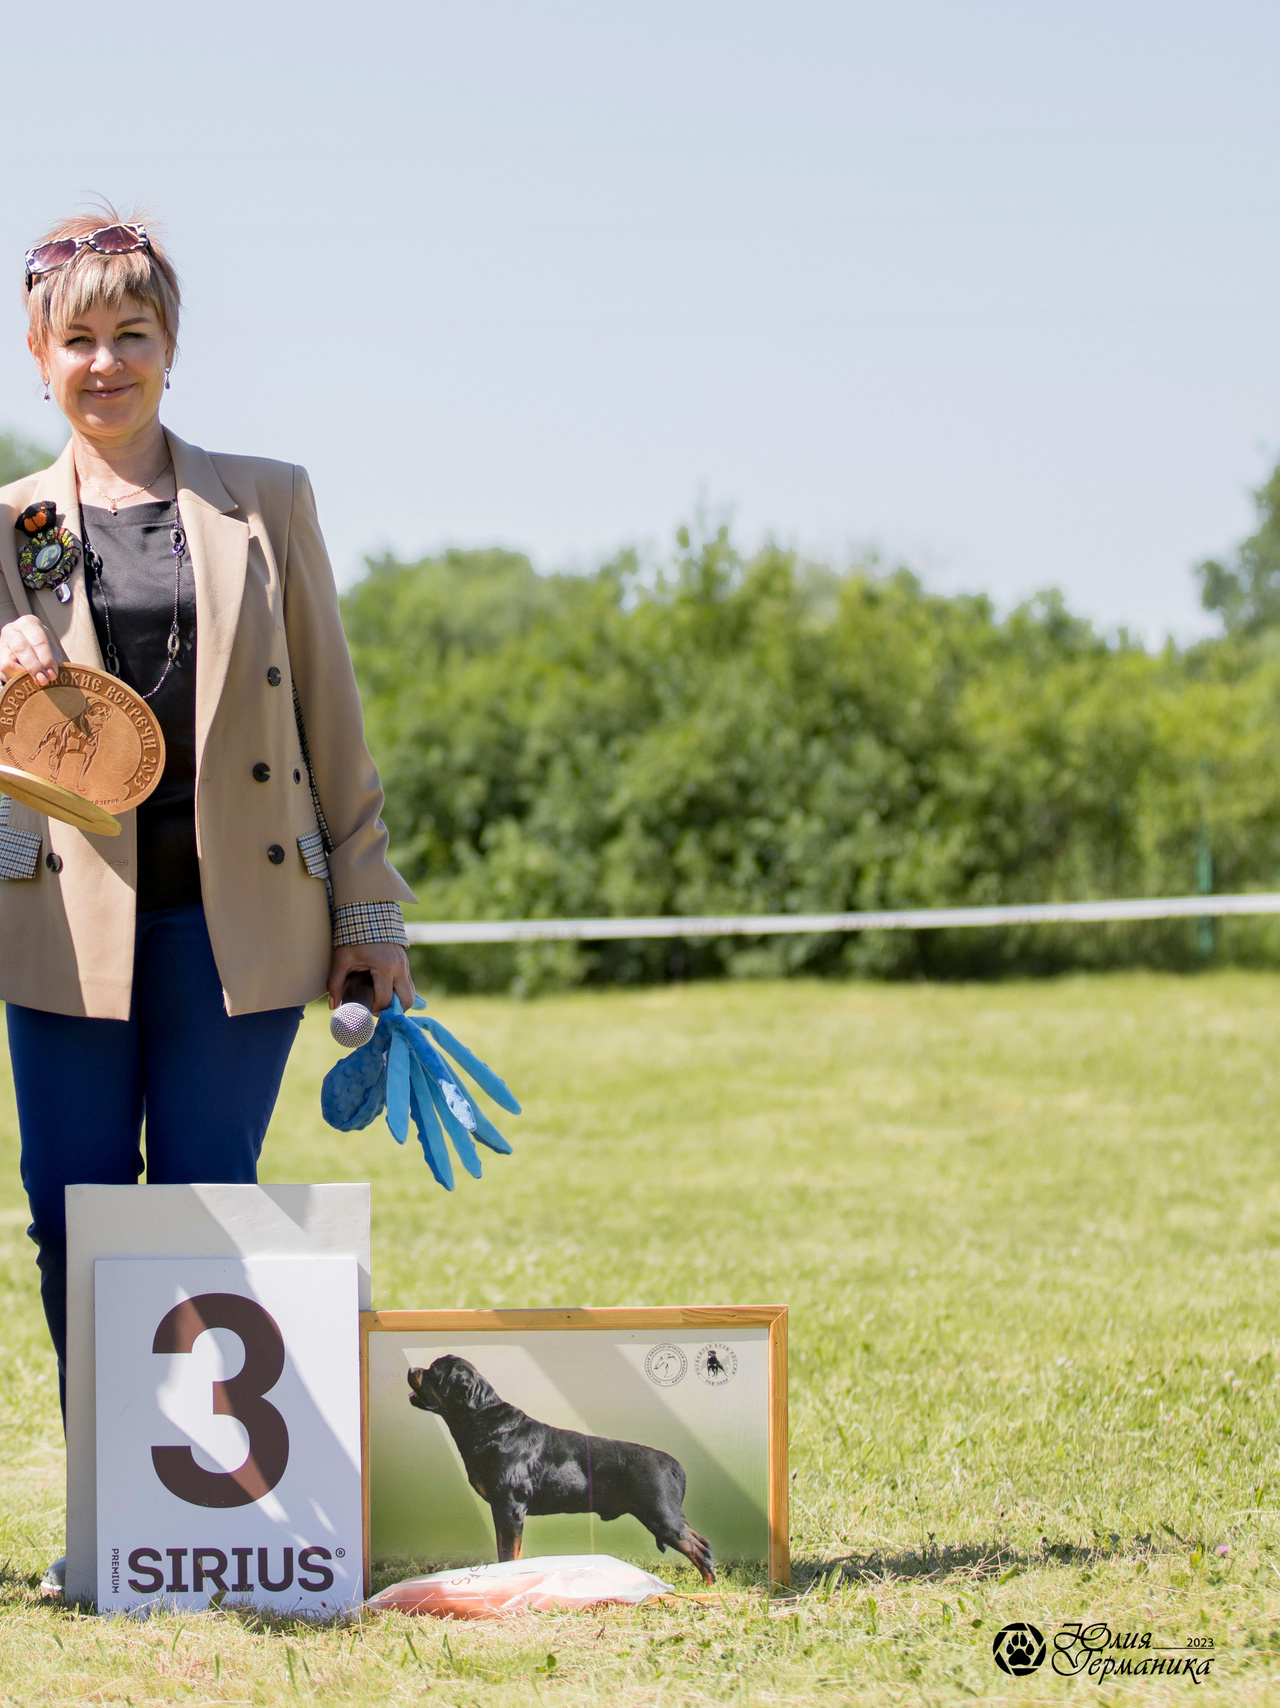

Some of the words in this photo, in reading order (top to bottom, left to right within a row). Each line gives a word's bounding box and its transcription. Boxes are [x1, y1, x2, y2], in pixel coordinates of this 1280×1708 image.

[0, 671, 102, 727] ВОРОНСКИЕ
[105, 685, 158, 750] ВСТРЕЧИ
[134, 756, 157, 790] 2023
[150, 1292, 290, 1509] 3
[111, 1548, 119, 1594] PREMIUM
